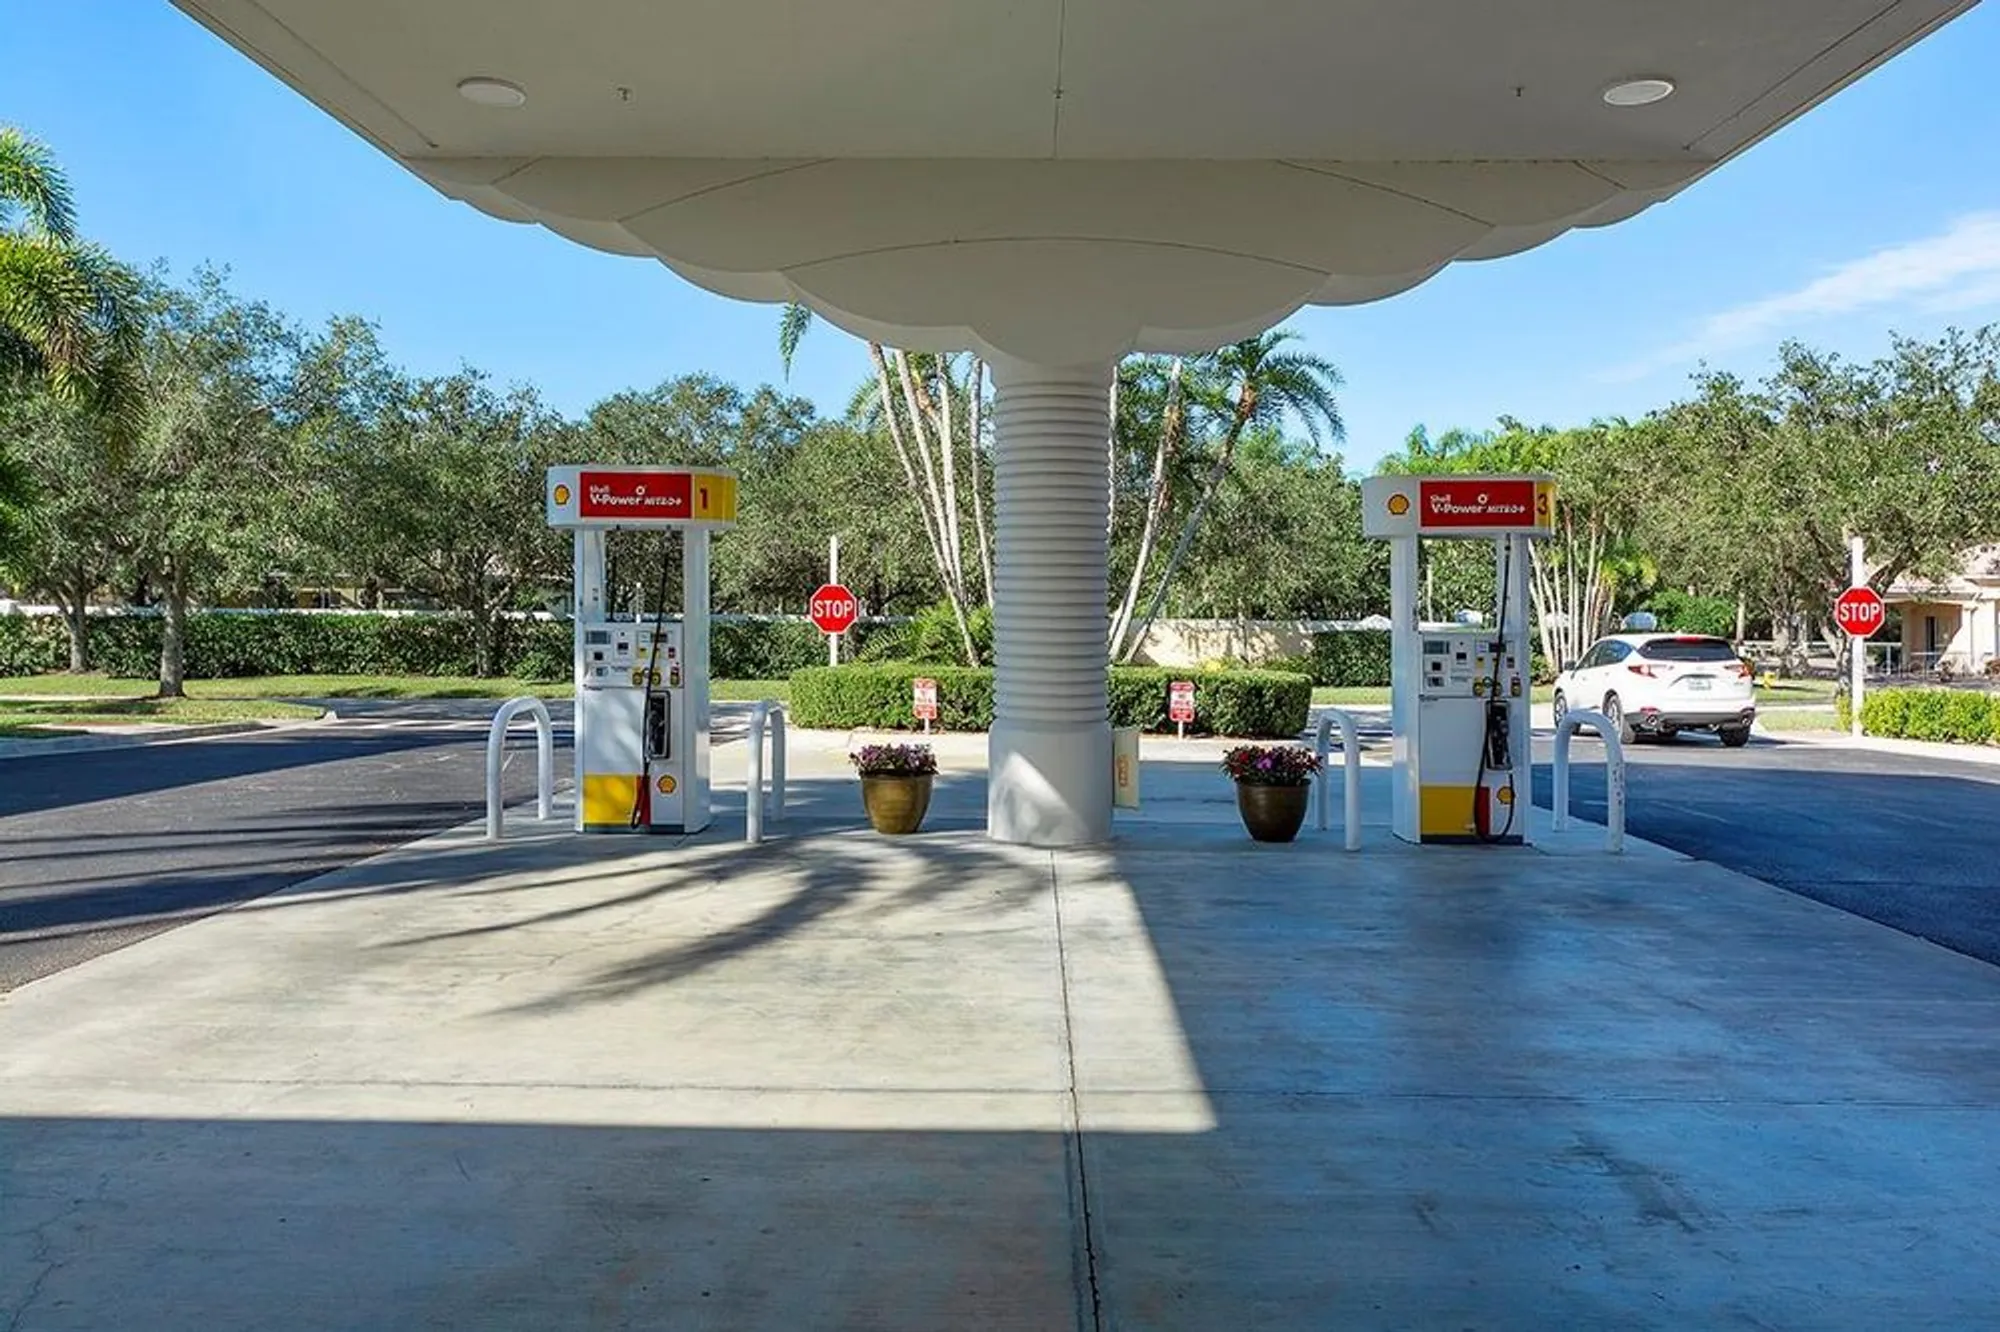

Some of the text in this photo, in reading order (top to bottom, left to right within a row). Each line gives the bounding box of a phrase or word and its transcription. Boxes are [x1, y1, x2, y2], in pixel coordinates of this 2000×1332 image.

[589, 493, 643, 505] V-Power
[699, 487, 708, 509] 1
[1430, 494, 1451, 503] Shell
[1537, 493, 1547, 515] 3
[1431, 503, 1484, 513] V-Power
[814, 600, 853, 618] STOP
[1840, 602, 1880, 621] STOP
